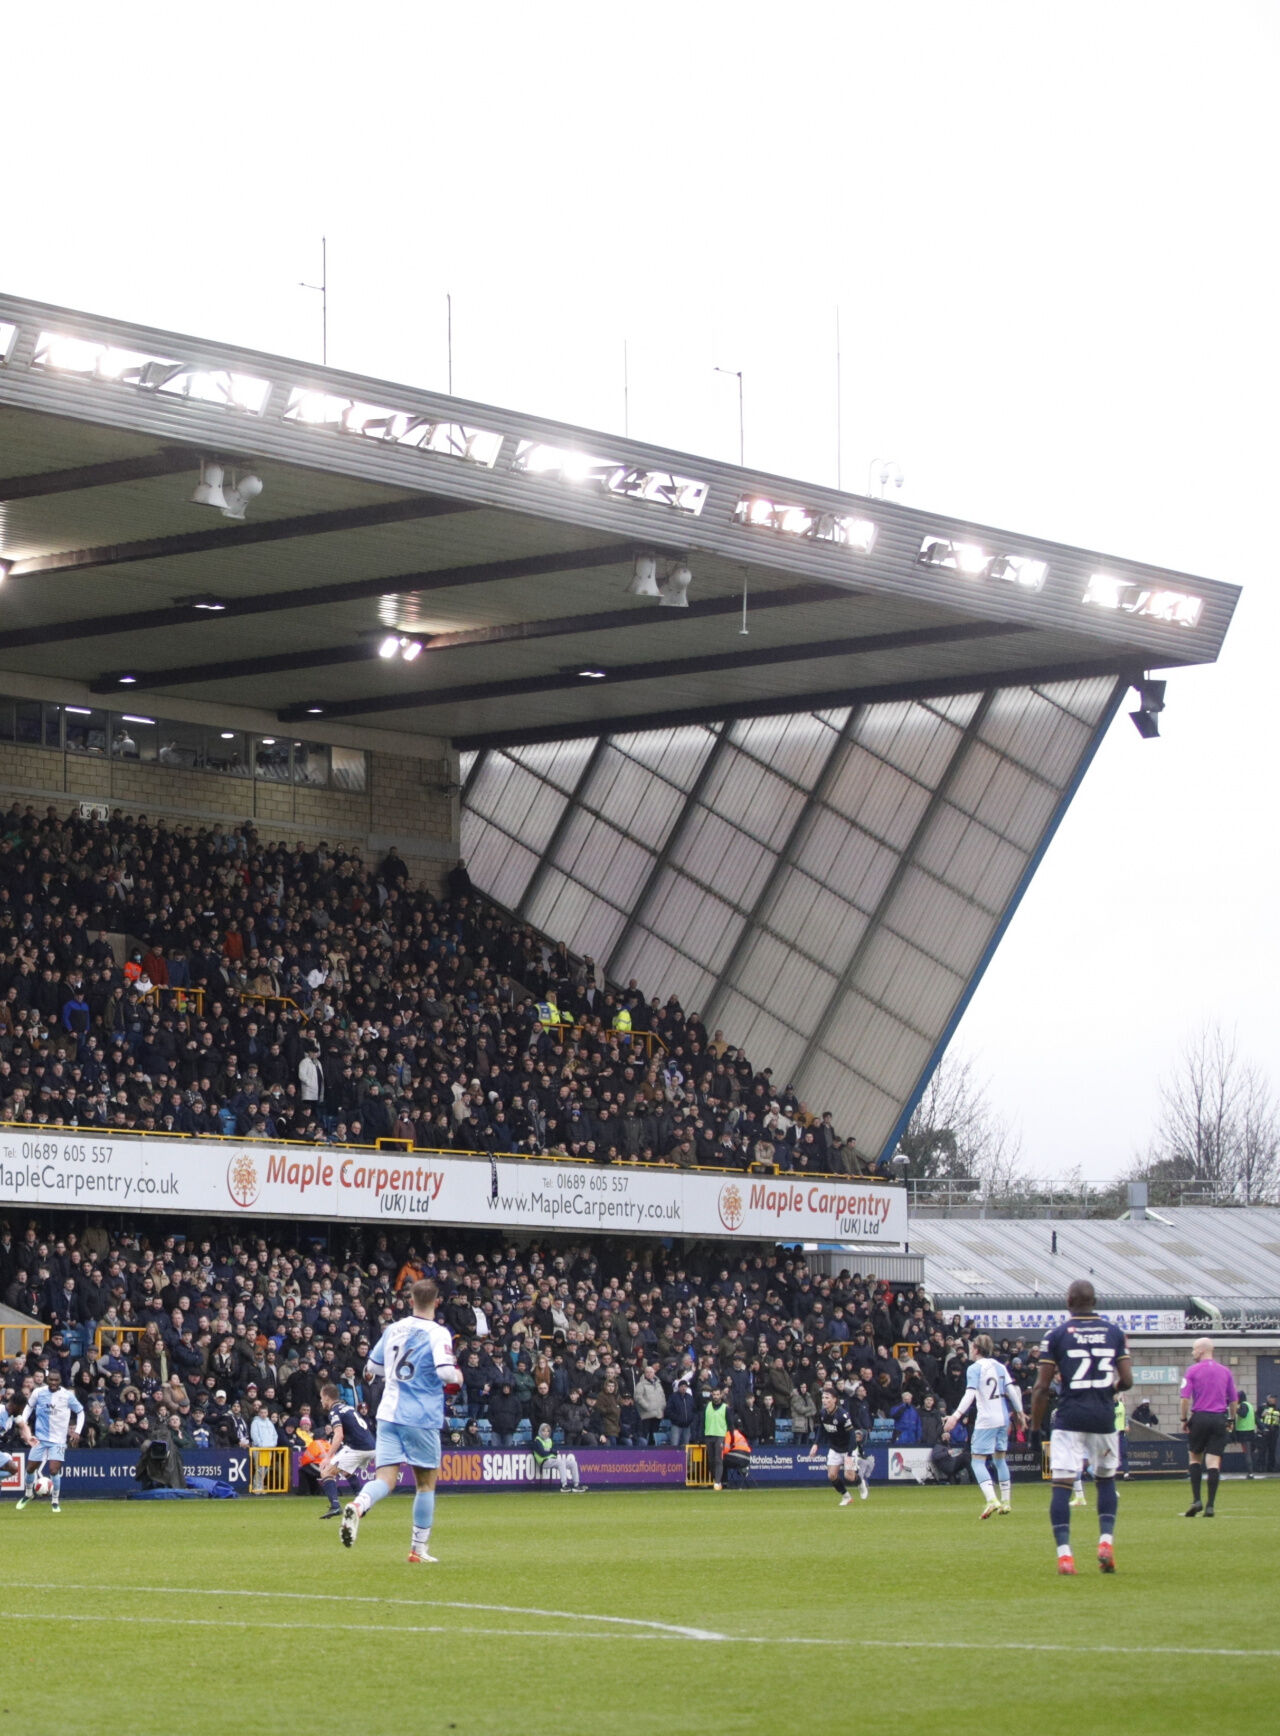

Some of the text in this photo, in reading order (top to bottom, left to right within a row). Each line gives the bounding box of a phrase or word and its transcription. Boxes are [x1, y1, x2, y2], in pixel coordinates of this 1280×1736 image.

[22, 1142, 58, 1160] 01689
[63, 1145, 86, 1162] 605
[91, 1146, 113, 1164] 557
[266, 1155, 444, 1200] Maple Carpentry
[556, 1175, 586, 1190] 01689
[590, 1177, 608, 1191] 605
[612, 1177, 629, 1192] 557
[380, 1193, 429, 1214] (UK) Ltd
[486, 1193, 681, 1223] www.MapleCarpentry.co.uk
[748, 1184, 891, 1223] Maple Carpentry
[839, 1217, 880, 1236] (UK) Ltd
[389, 1345, 415, 1381] 16
[1067, 1348, 1116, 1390] 23
[1141, 1370, 1164, 1381] EXIT
[59, 1465, 106, 1477] URNHILL
[109, 1465, 137, 1477] KITC
[197, 1465, 221, 1476] 373515
[437, 1453, 481, 1481] ASONS
